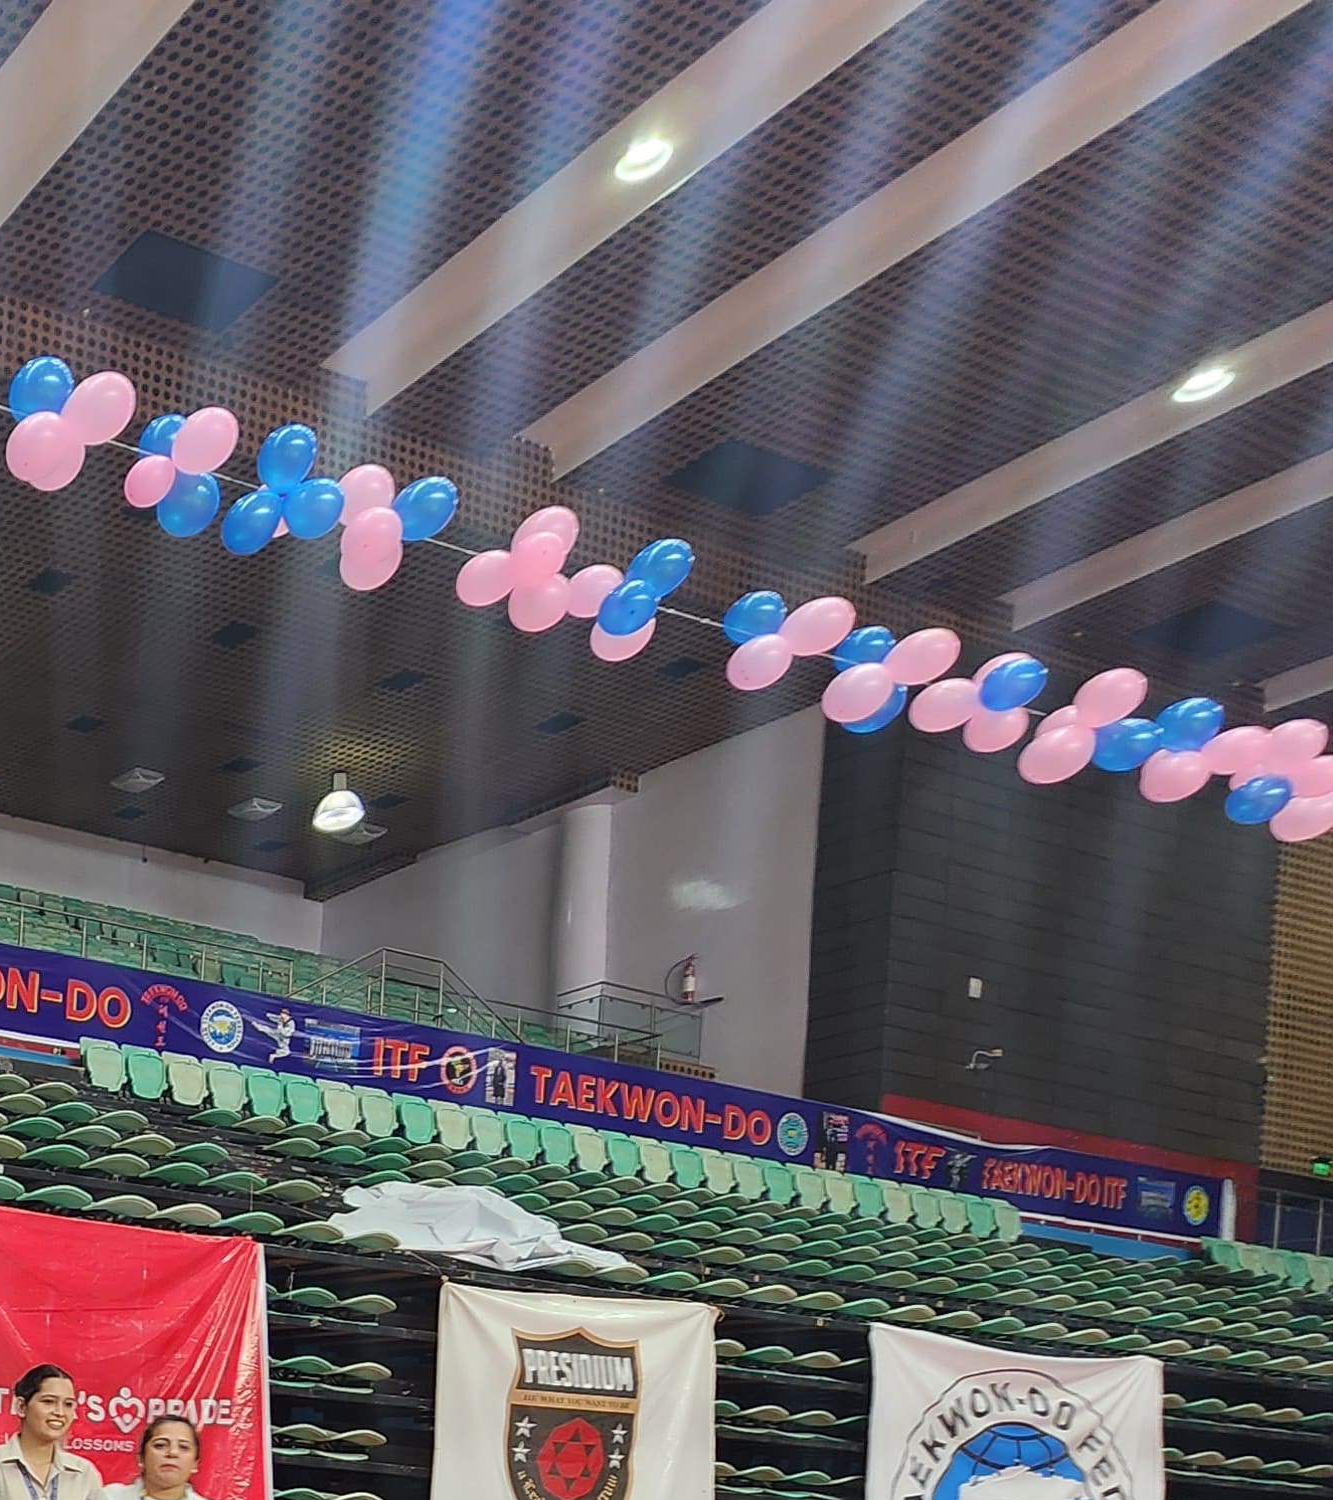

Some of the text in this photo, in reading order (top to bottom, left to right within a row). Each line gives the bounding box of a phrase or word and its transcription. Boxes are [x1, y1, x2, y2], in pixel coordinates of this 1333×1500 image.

[373, 1037, 430, 1082] ITF
[529, 1064, 772, 1146] TAEKWON-DO
[893, 1139, 946, 1180] ITF
[521, 1348, 634, 1392] PRESIDIUM
[64, 1438, 136, 1454] LOSSOMS
